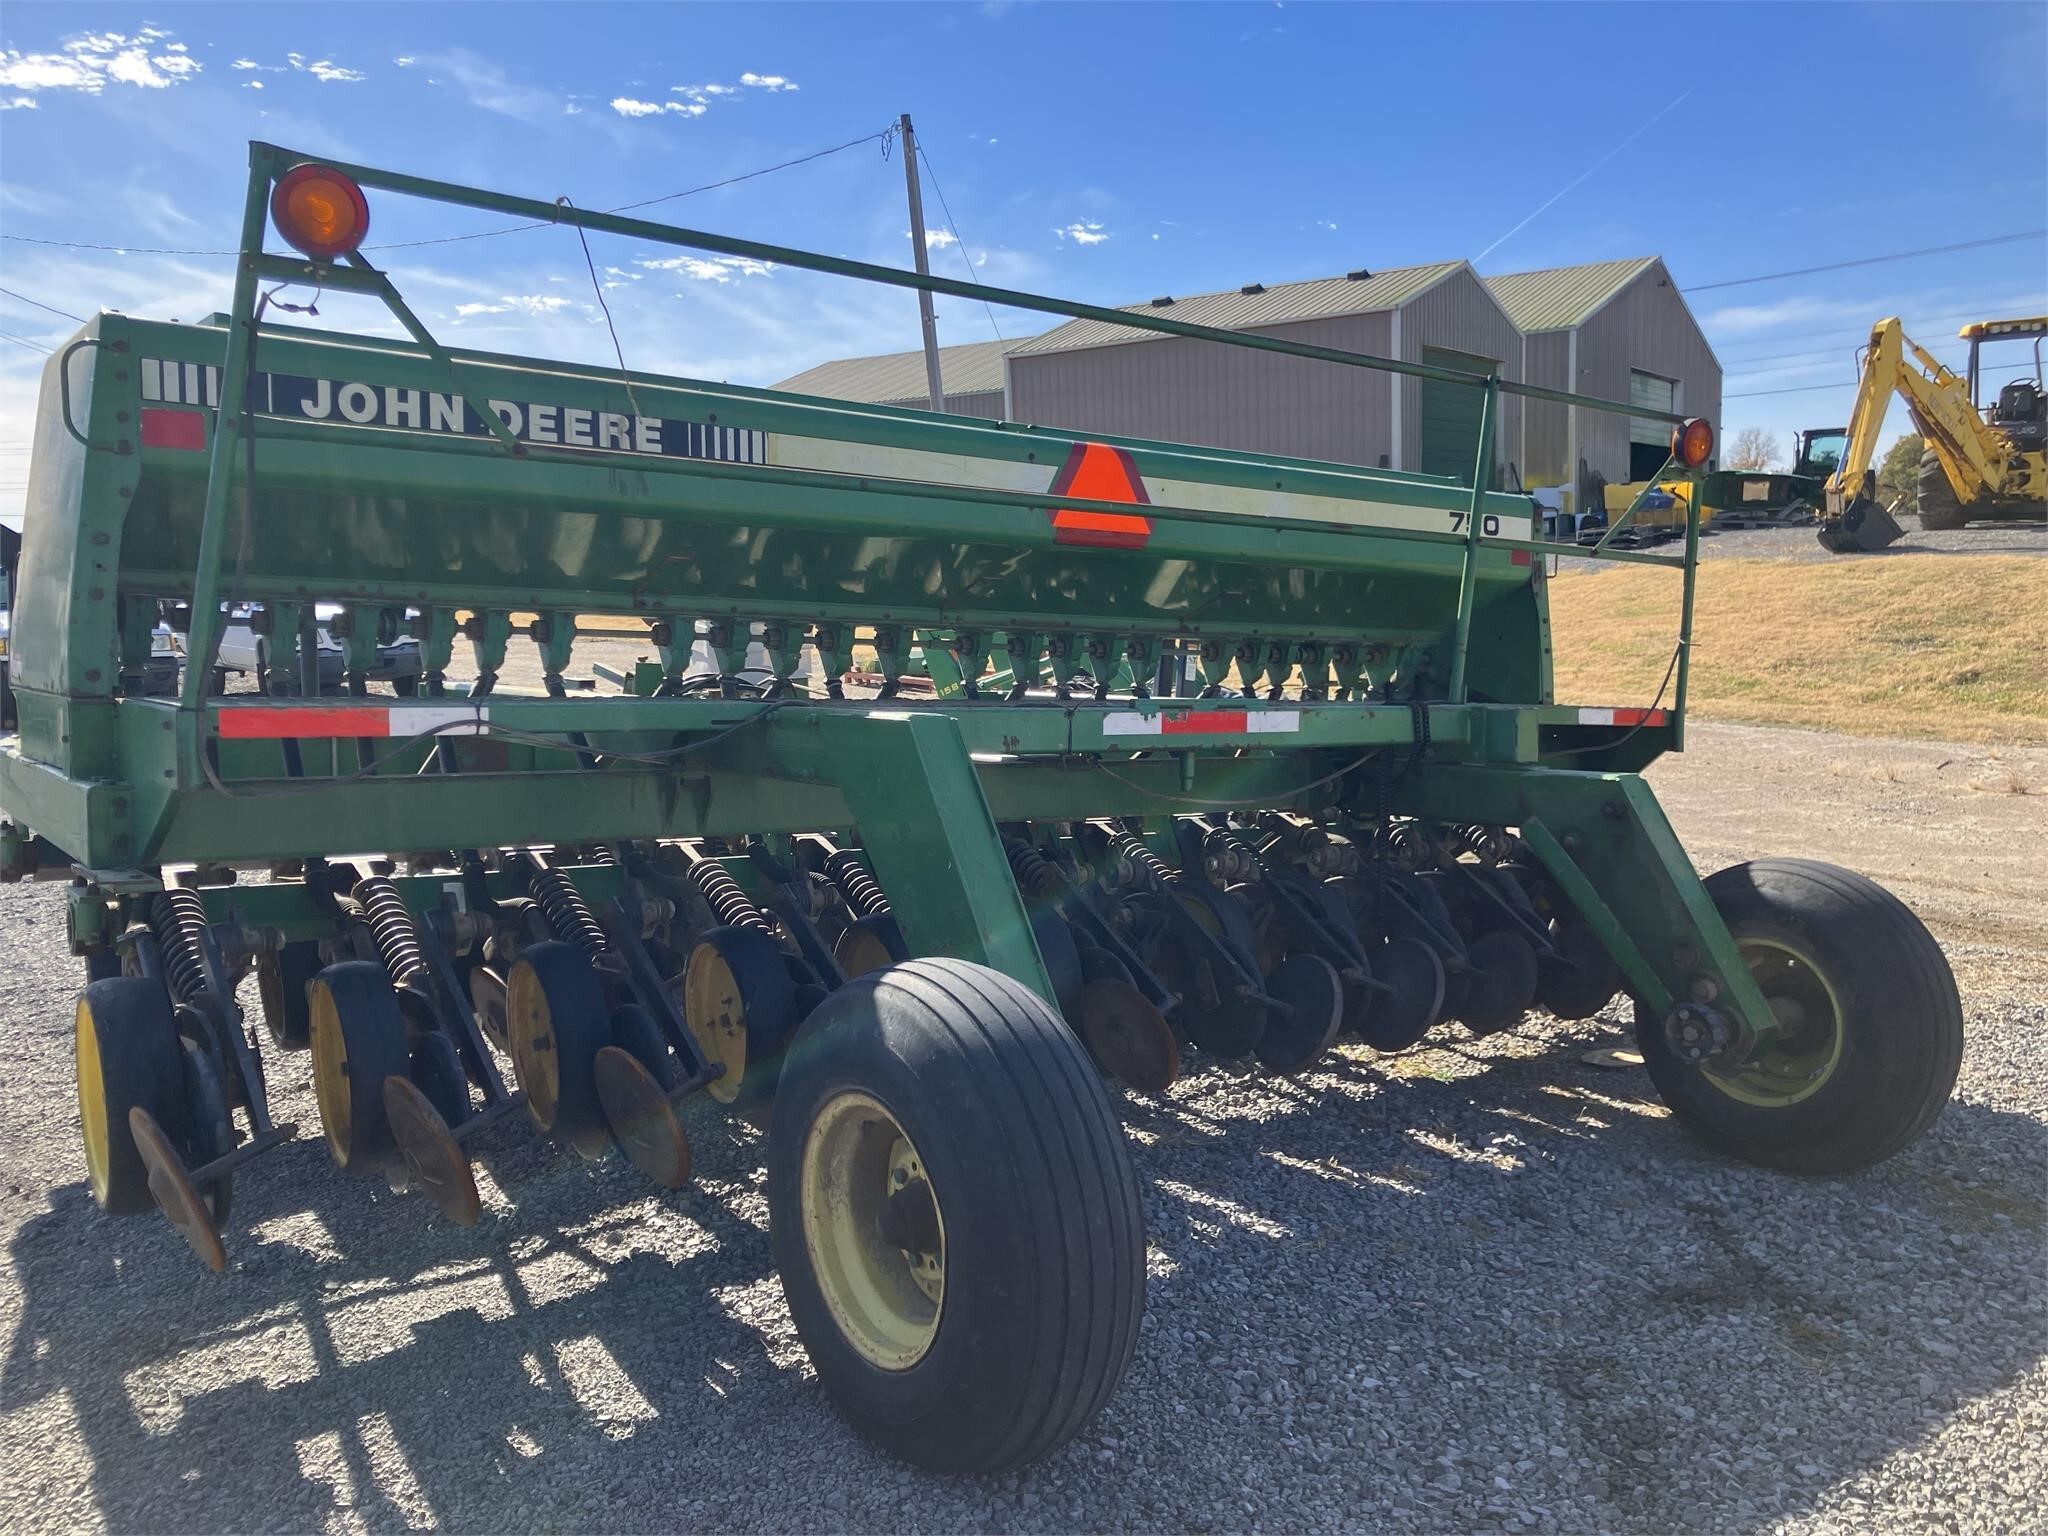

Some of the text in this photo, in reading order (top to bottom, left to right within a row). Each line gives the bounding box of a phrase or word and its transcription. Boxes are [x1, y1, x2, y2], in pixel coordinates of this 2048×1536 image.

[301, 379, 662, 453] JOHN DEERE
[1449, 511, 1500, 536] 70
[940, 682, 959, 696] 158
